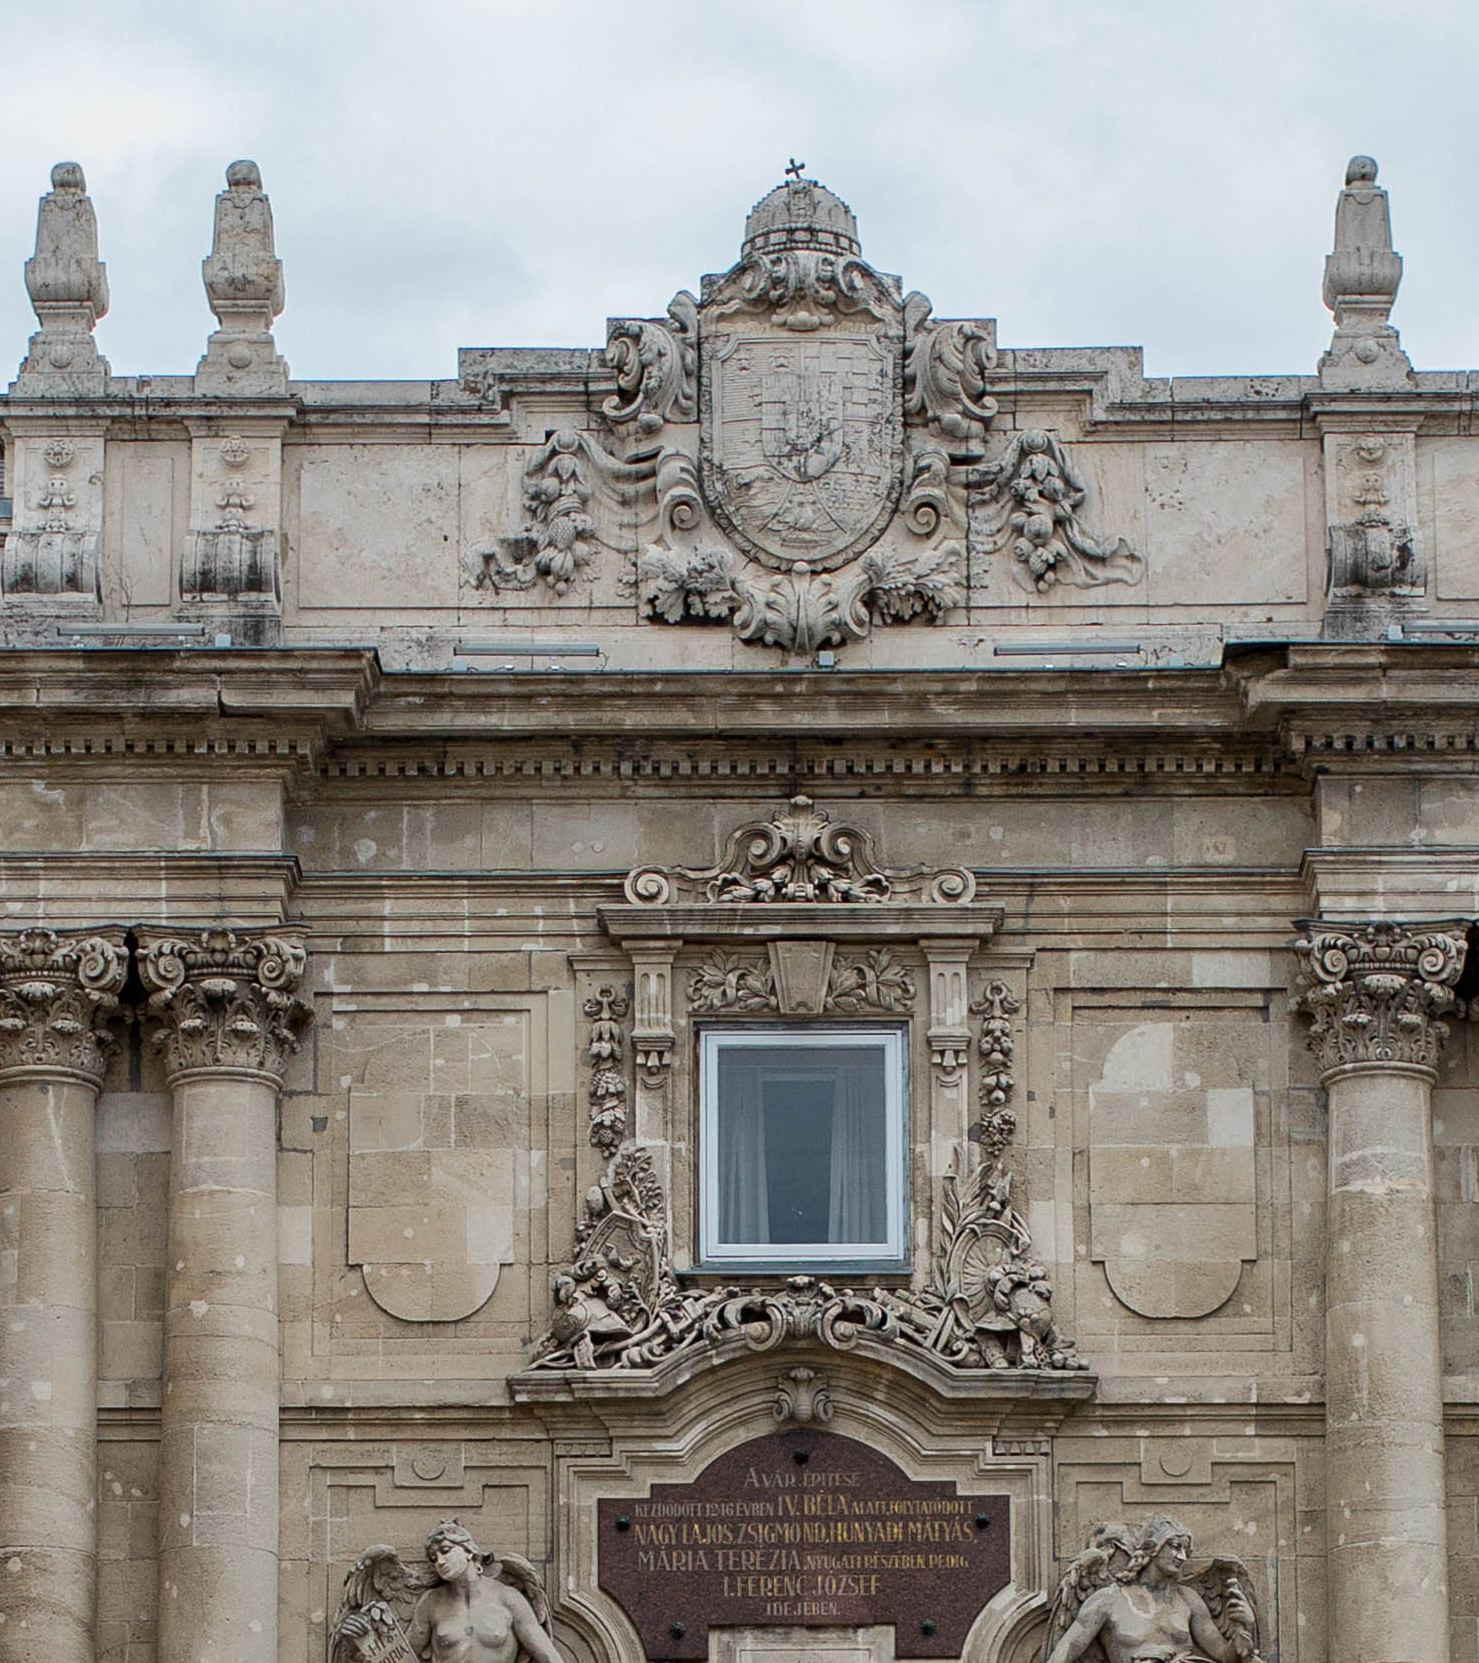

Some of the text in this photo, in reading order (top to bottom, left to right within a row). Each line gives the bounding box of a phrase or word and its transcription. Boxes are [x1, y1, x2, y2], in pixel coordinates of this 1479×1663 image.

[803, 1489, 850, 1515] BÉLA
[634, 1523, 680, 1545] NAGY
[638, 1545, 710, 1571] MÁRIA
[812, 1570, 881, 1596] JÓZSEF
